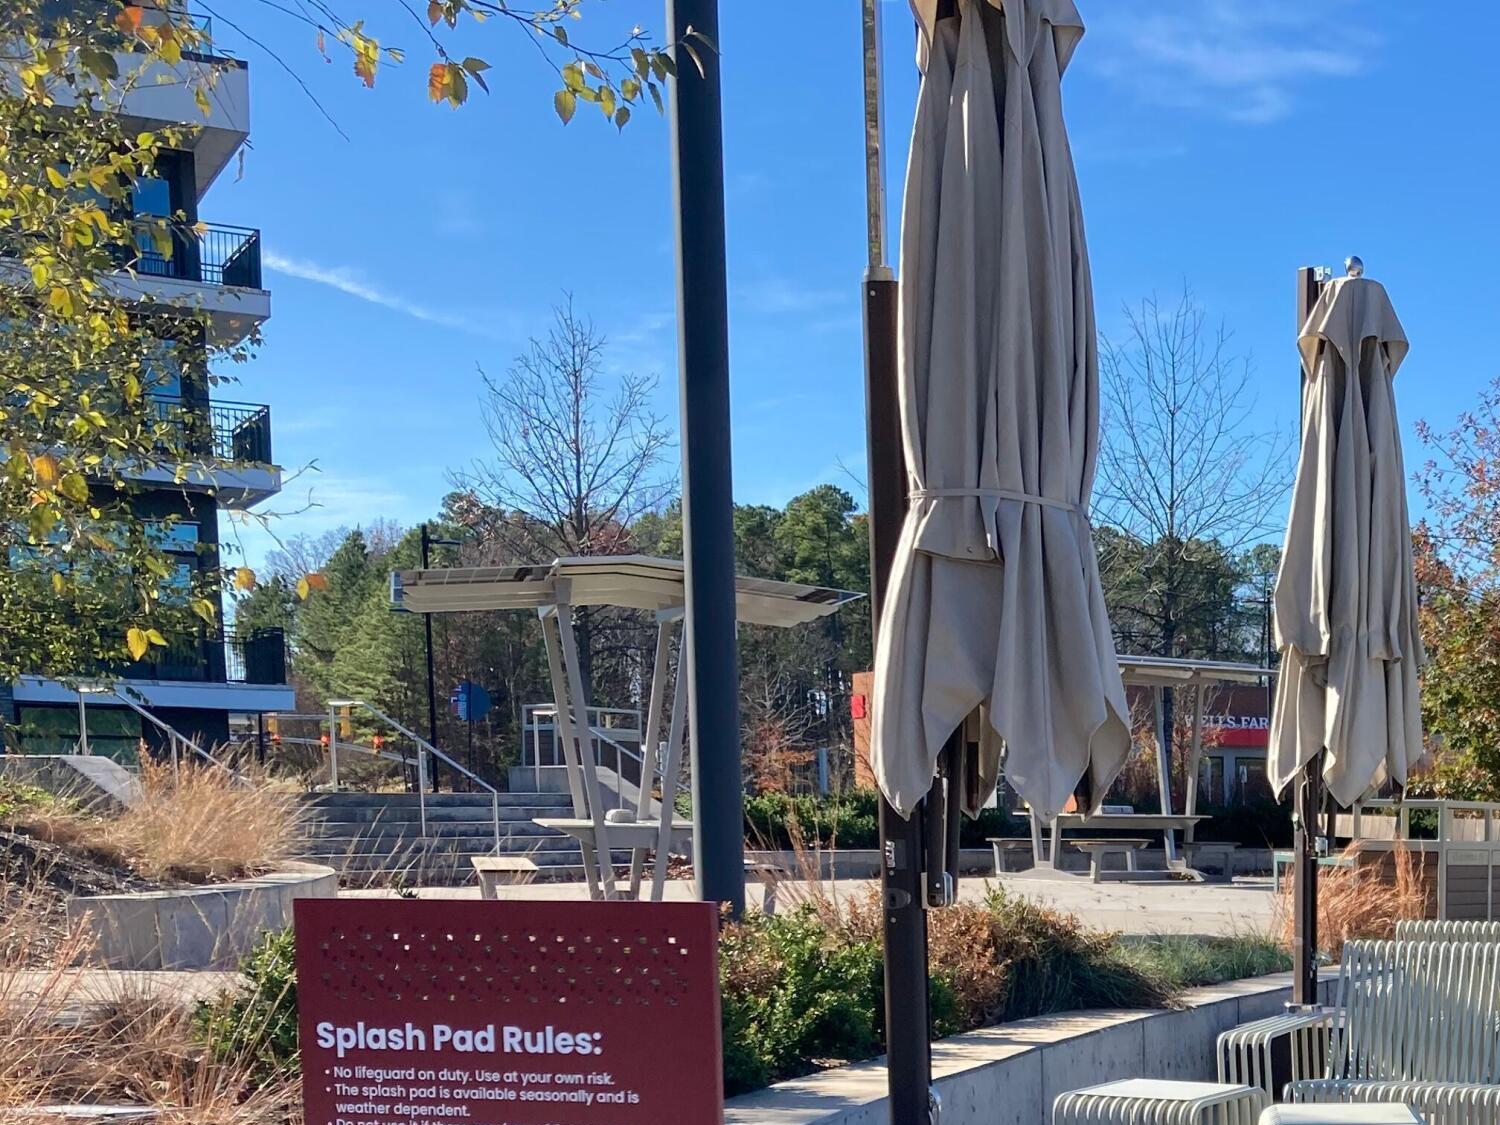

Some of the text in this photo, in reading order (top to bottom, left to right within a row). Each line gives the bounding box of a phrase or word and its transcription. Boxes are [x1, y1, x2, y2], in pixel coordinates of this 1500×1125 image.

[317, 1022, 602, 1058] Splash Pad Rules:
[334, 1066, 615, 1086] No lifeguard on duty. Use at your own risk.
[334, 1083, 639, 1105] The splash pad is available seasonally and is
[336, 1102, 470, 1118] weather dependent.
